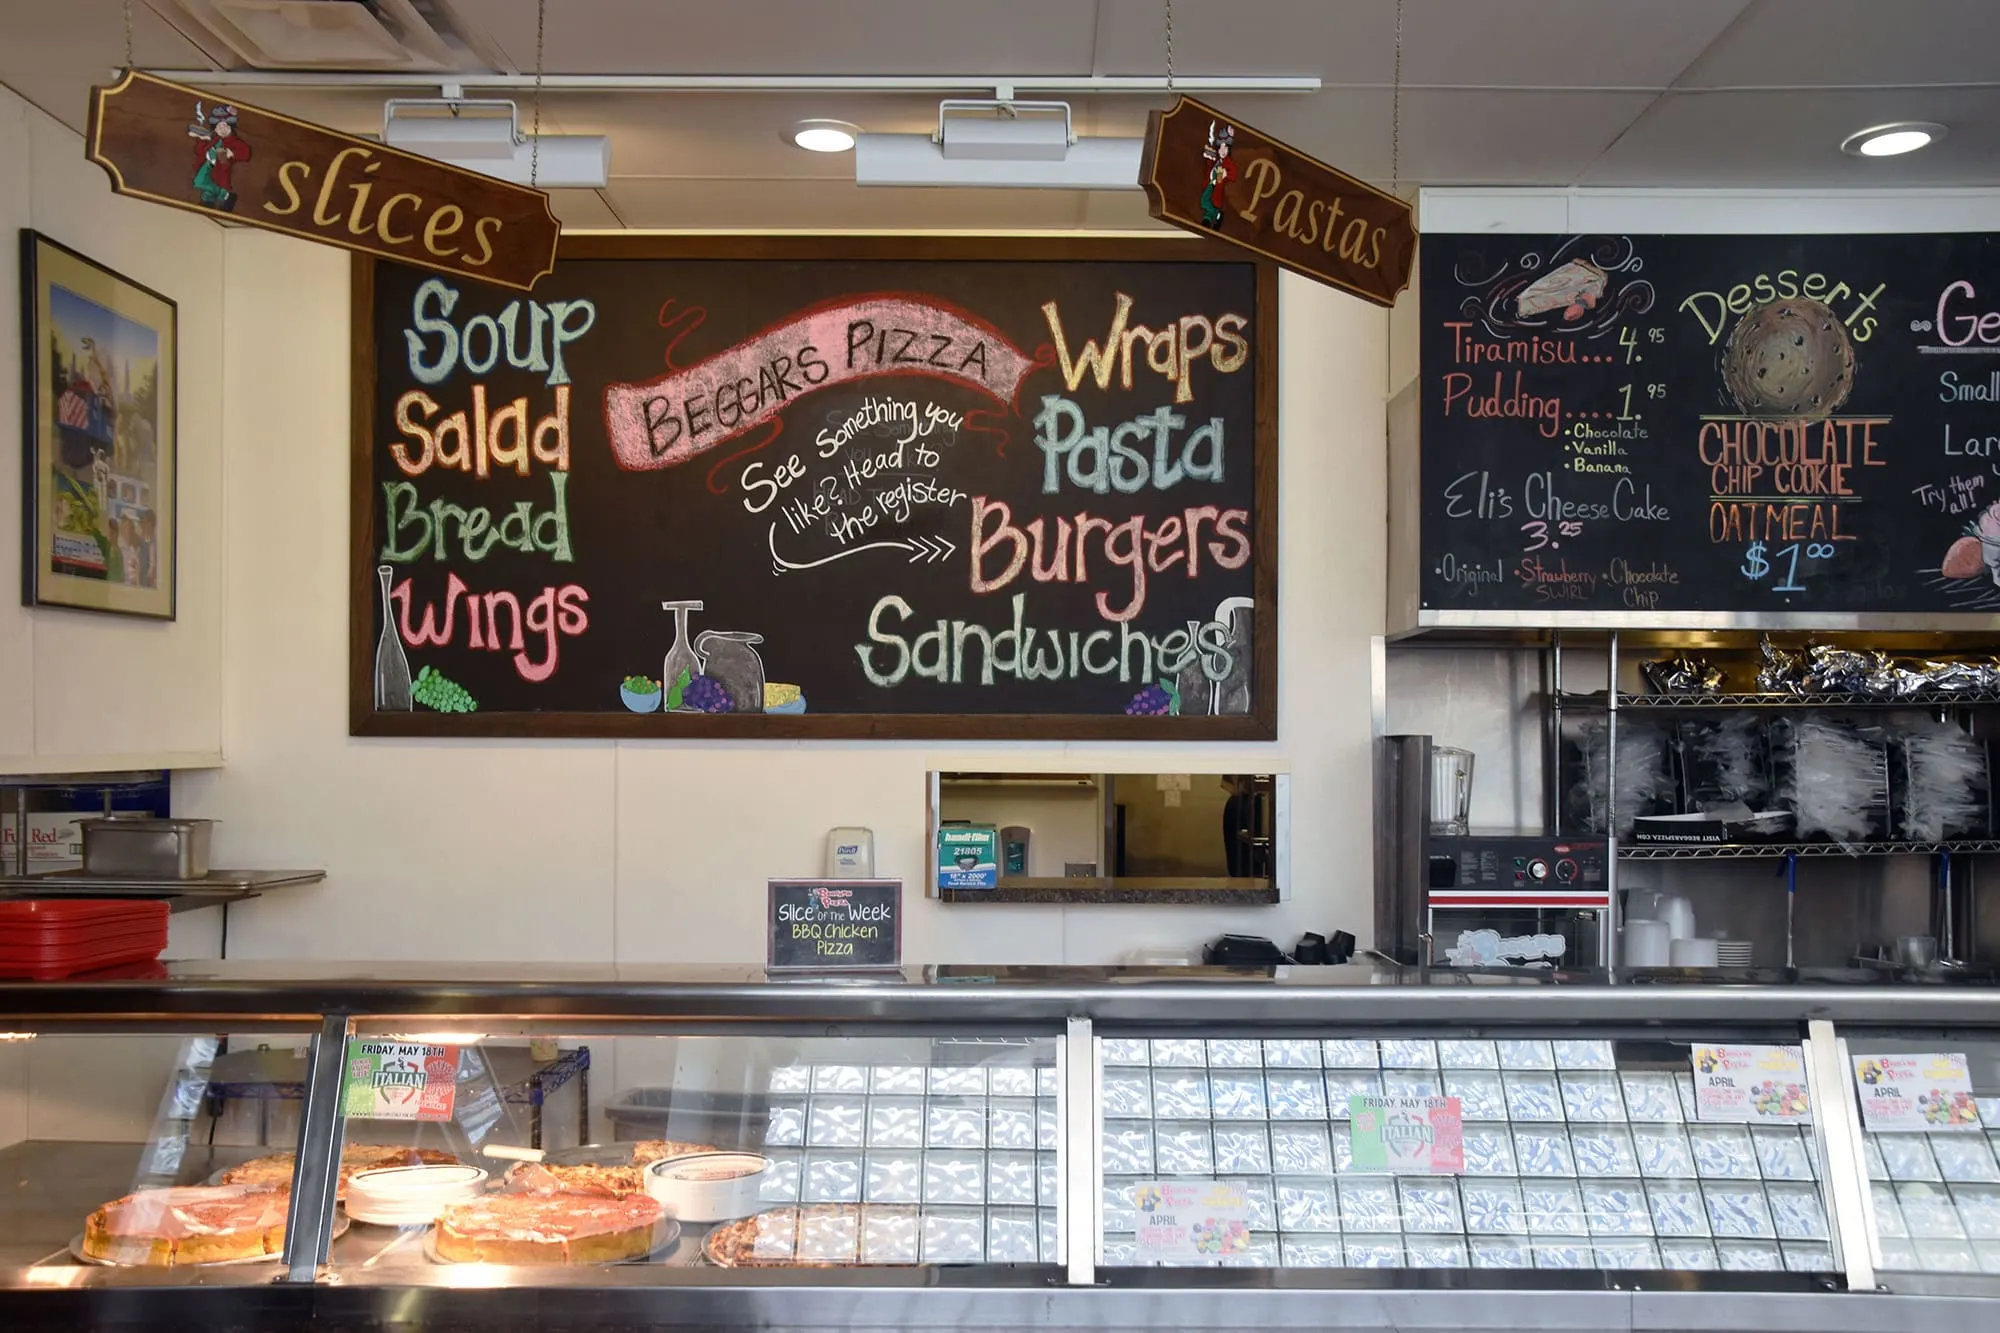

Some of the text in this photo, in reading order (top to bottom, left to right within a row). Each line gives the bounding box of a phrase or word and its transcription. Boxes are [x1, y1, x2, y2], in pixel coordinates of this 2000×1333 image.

[264, 147, 502, 267] slices
[1239, 157, 1387, 270] Pastas
[1679, 269, 1887, 345] Desserts
[403, 278, 596, 385] Soup
[1040, 291, 1249, 403] Wraps
[643, 320, 987, 456] BEGGARS PIZZA
[390, 384, 571, 479] Salad
[1032, 394, 1225, 494] Pasta
[1572, 440, 1628, 456] Vanilla
[1574, 422, 1649, 439] Chocolate
[1699, 419, 1891, 467] CHOCOLATE
[740, 396, 963, 513] See Something you
[1574, 457, 1631, 473] Banana
[781, 442, 940, 534] like? Head to
[1444, 471, 1670, 521] Eli's Cheese Cake
[1711, 463, 1853, 495] CHIP COOKIE
[1912, 475, 1984, 513] Try them
[380, 470, 575, 563] Bread
[829, 477, 967, 544] the register
[1950, 490, 1977, 514] all!
[1709, 501, 1857, 544] OATMEAL
[969, 496, 1251, 622] Burgers
[1442, 552, 1503, 597] Original
[1520, 556, 1597, 591] Strawberry
[1610, 556, 1680, 585] Chocolate
[1622, 588, 1660, 609] Chip
[391, 571, 589, 683] Wings
[855, 593, 1236, 686] Sandwiches
[31, 827, 57, 843] Red
[954, 847, 982, 856] 21805
[1702, 833, 1721, 842] VISIT
[778, 903, 815, 921] Slice
[848, 903, 891, 921] Week
[792, 923, 878, 939] BBQ Chicken
[817, 940, 854, 955] Pizza
[399, 1045, 419, 1056] MAY
[422, 1046, 445, 1057] 18TH
[373, 1071, 425, 1090] ITALIAN
[1709, 1076, 1736, 1088] APRIL
[1874, 1087, 1902, 1098] APRIL
[1400, 1098, 1421, 1108] MAY
[1424, 1098, 1446, 1108] 18TH
[1381, 1125, 1433, 1144] ITALIAN
[1149, 1215, 1178, 1226] APRIL
